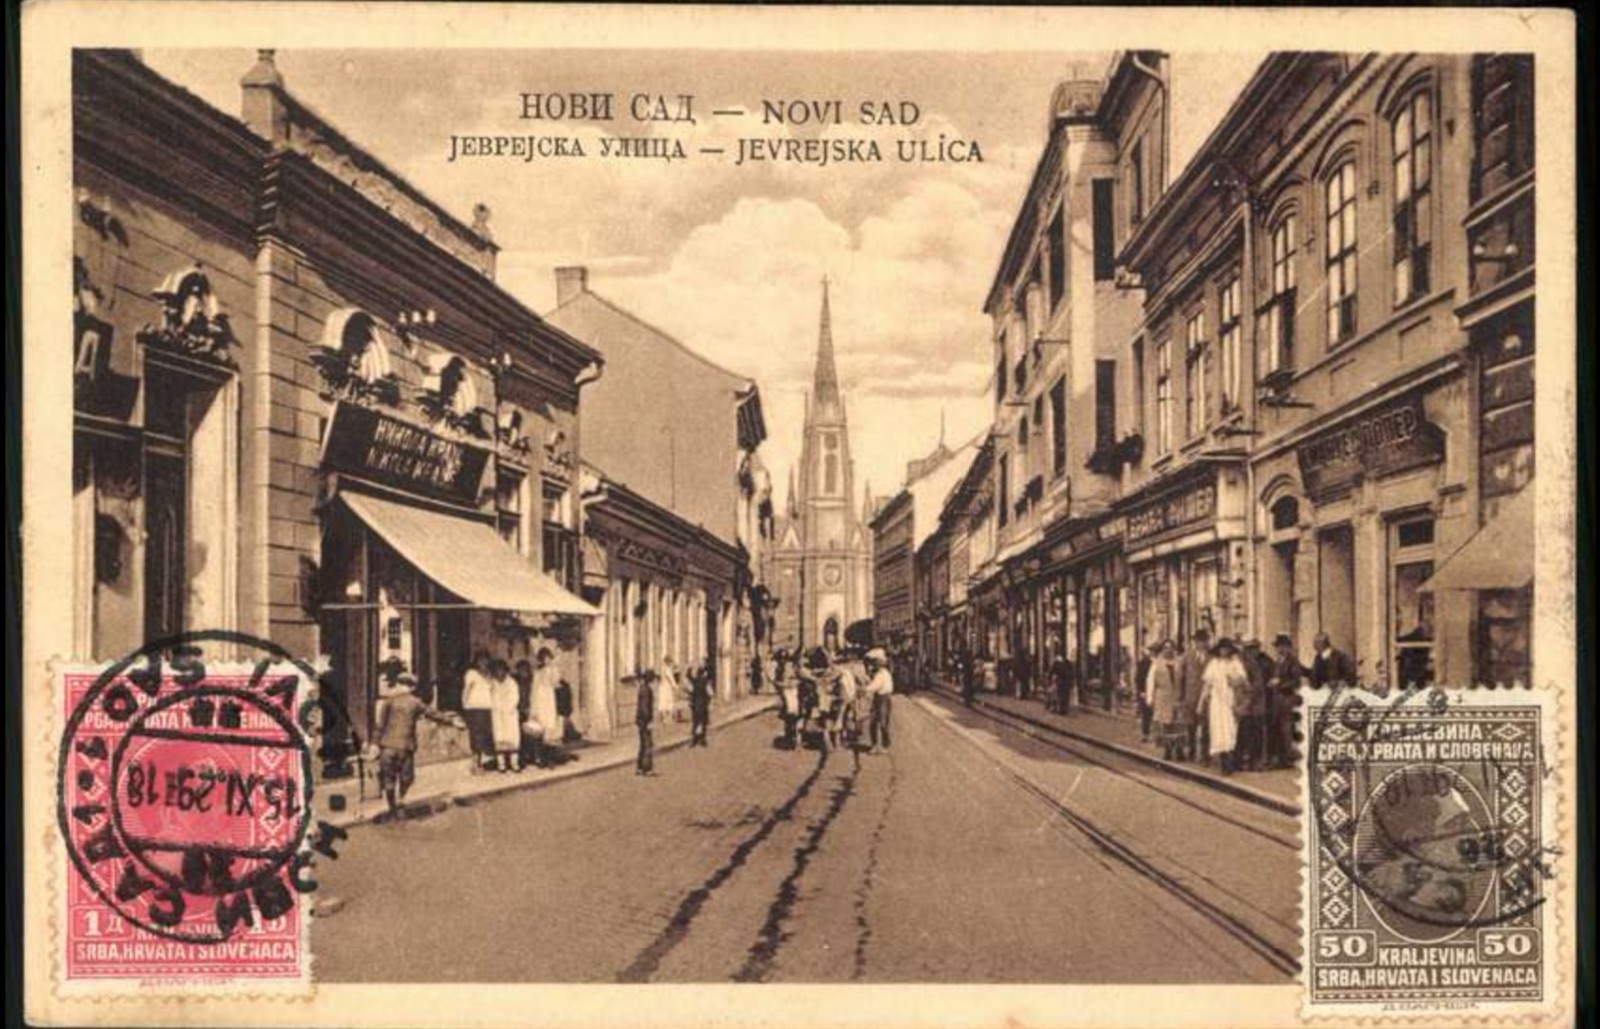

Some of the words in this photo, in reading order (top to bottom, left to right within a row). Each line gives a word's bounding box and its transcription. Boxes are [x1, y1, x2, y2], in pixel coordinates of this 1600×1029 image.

[1319, 935, 1367, 957] 50
[1483, 933, 1532, 956] 50
[1378, 947, 1477, 966] KRALJEVINA
[1440, 967, 1537, 986] SLOVENACA
